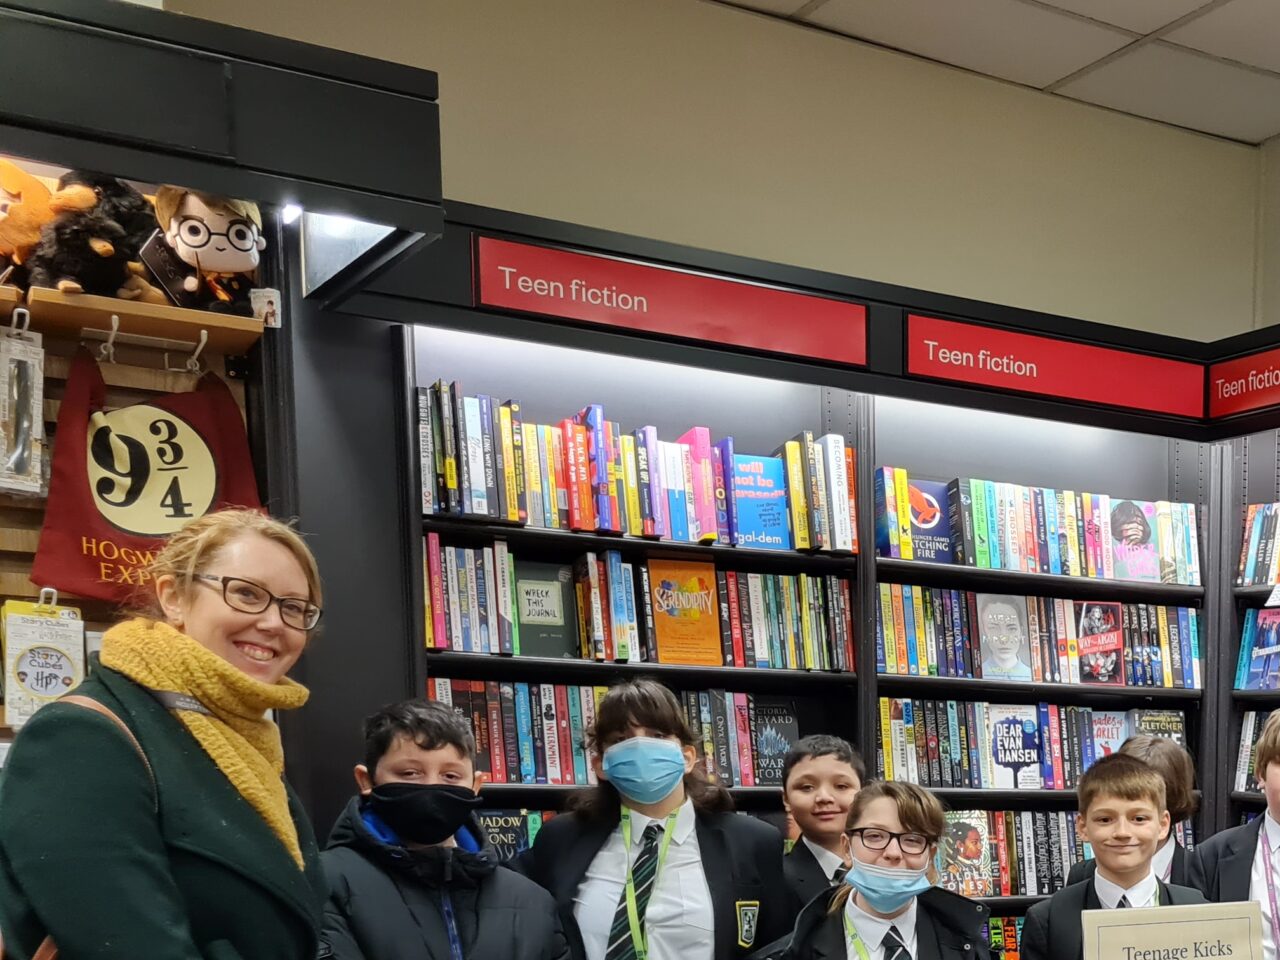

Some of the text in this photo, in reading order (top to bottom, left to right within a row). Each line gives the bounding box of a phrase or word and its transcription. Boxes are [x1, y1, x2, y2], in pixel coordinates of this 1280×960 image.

[497, 265, 648, 313] Teen fiction
[923, 340, 1038, 378] Teen fiction
[1215, 375, 1246, 400] Teen
[91, 425, 150, 508] 9
[832, 439, 843, 487] BECOMING
[714, 463, 727, 522] PROUD
[738, 531, 782, 545] gal-dem
[82, 536, 157, 568] HOGW
[911, 540, 948, 551] ATCHING
[917, 549, 936, 559] FIRE
[524, 588, 550, 598] WRECK
[526, 599, 544, 608] THIS
[654, 587, 713, 615] SERENDIPITY
[526, 607, 558, 618] JOURNAL
[29, 649, 64, 663] Story
[29, 659, 63, 671] Cubes
[996, 723, 1023, 737] DEAR
[1141, 721, 1183, 732] FLETCHER
[997, 736, 1023, 751] EVAN
[998, 749, 1038, 763] HANSEN
[480, 816, 522, 828] ADOW
[489, 833, 516, 844] ONE
[1193, 940, 1233, 958] Kicks
